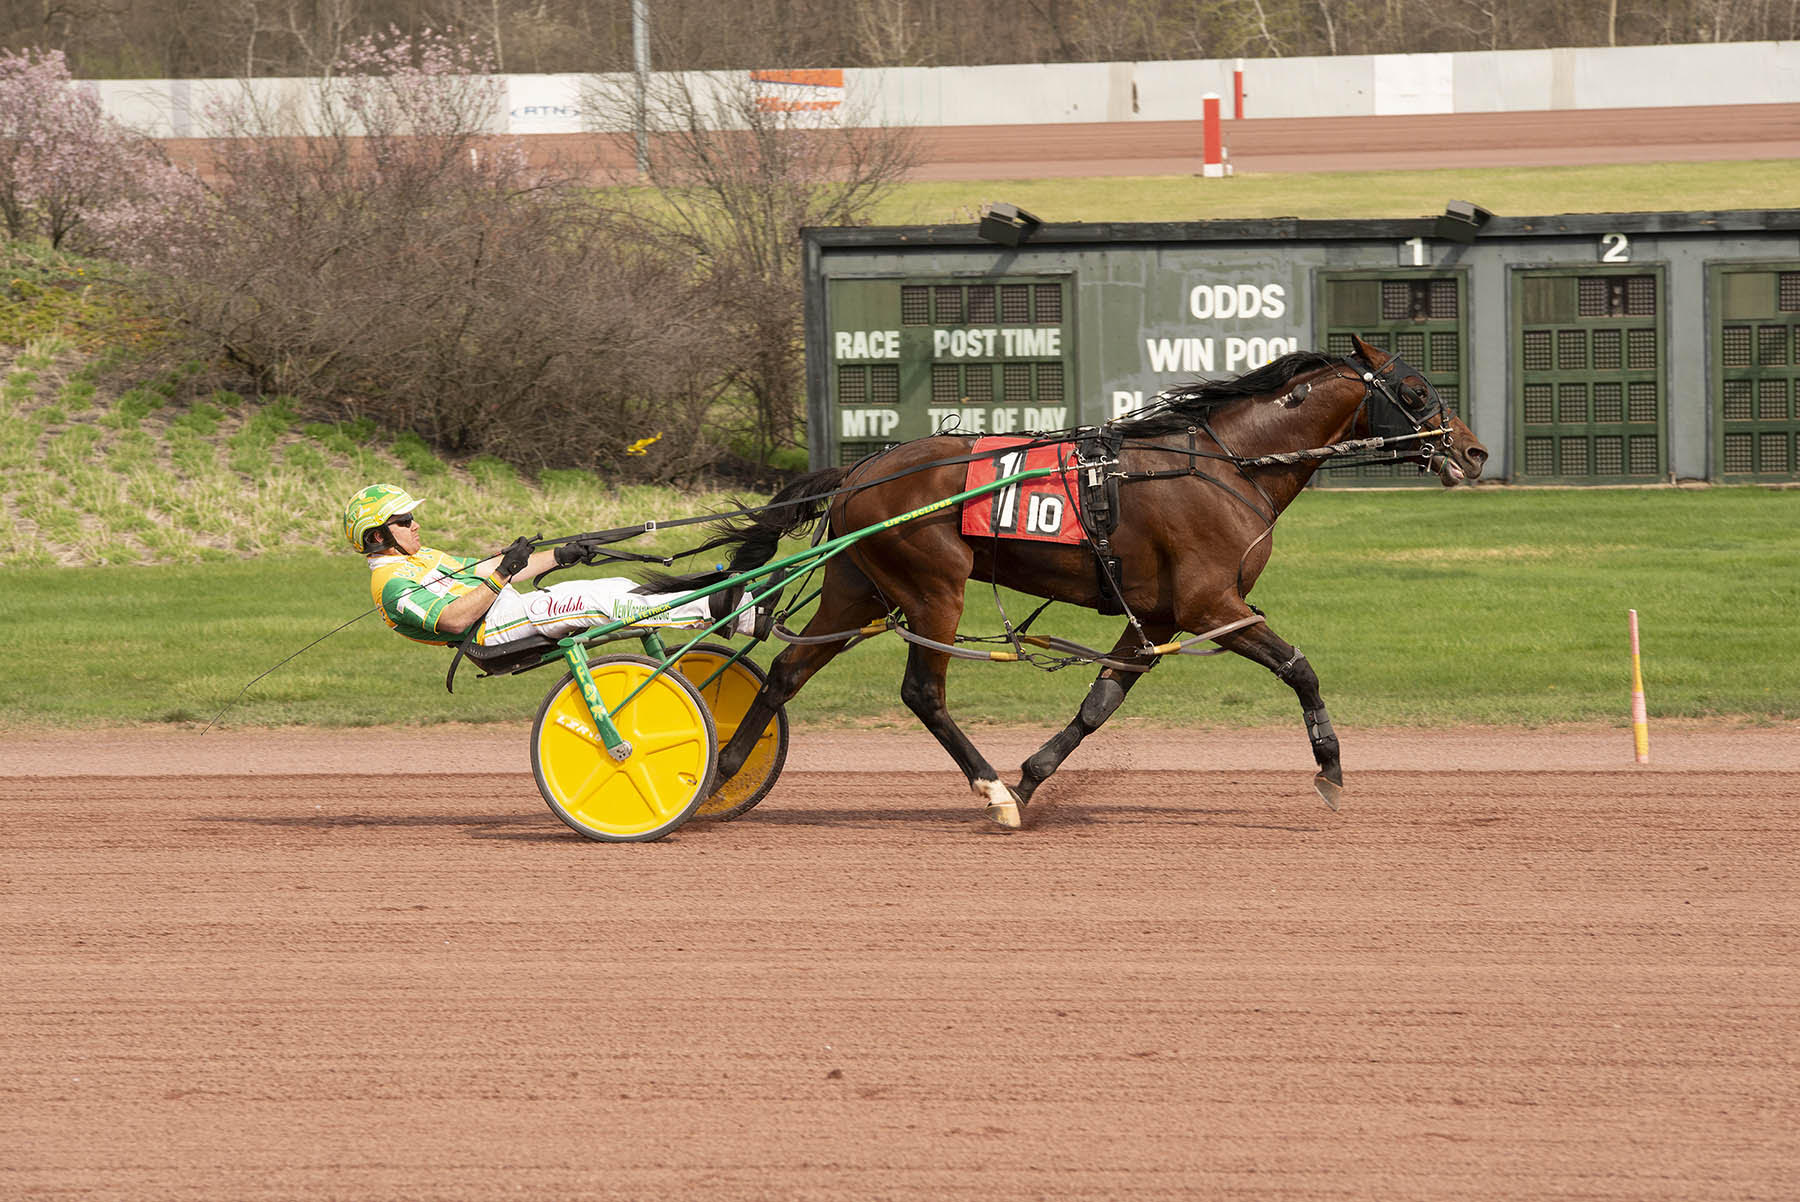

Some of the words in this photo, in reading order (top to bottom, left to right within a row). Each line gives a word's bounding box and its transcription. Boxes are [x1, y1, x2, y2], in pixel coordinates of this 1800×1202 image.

[1405, 238, 1424, 266] 1
[1601, 232, 1629, 263] 2
[1190, 284, 1285, 319] ODDS
[835, 331, 900, 359] RACE
[934, 329, 997, 358] POST
[1001, 328, 1061, 357] TIME
[1146, 338, 1215, 372] WIN
[842, 409, 899, 437] MTP
[928, 408, 985, 435] TIME
[992, 408, 1018, 433] OF
[1023, 407, 1068, 434] DAY
[1027, 495, 1062, 533] 10
[530, 595, 585, 617] Walsh
[622, 614, 637, 626] TIM
